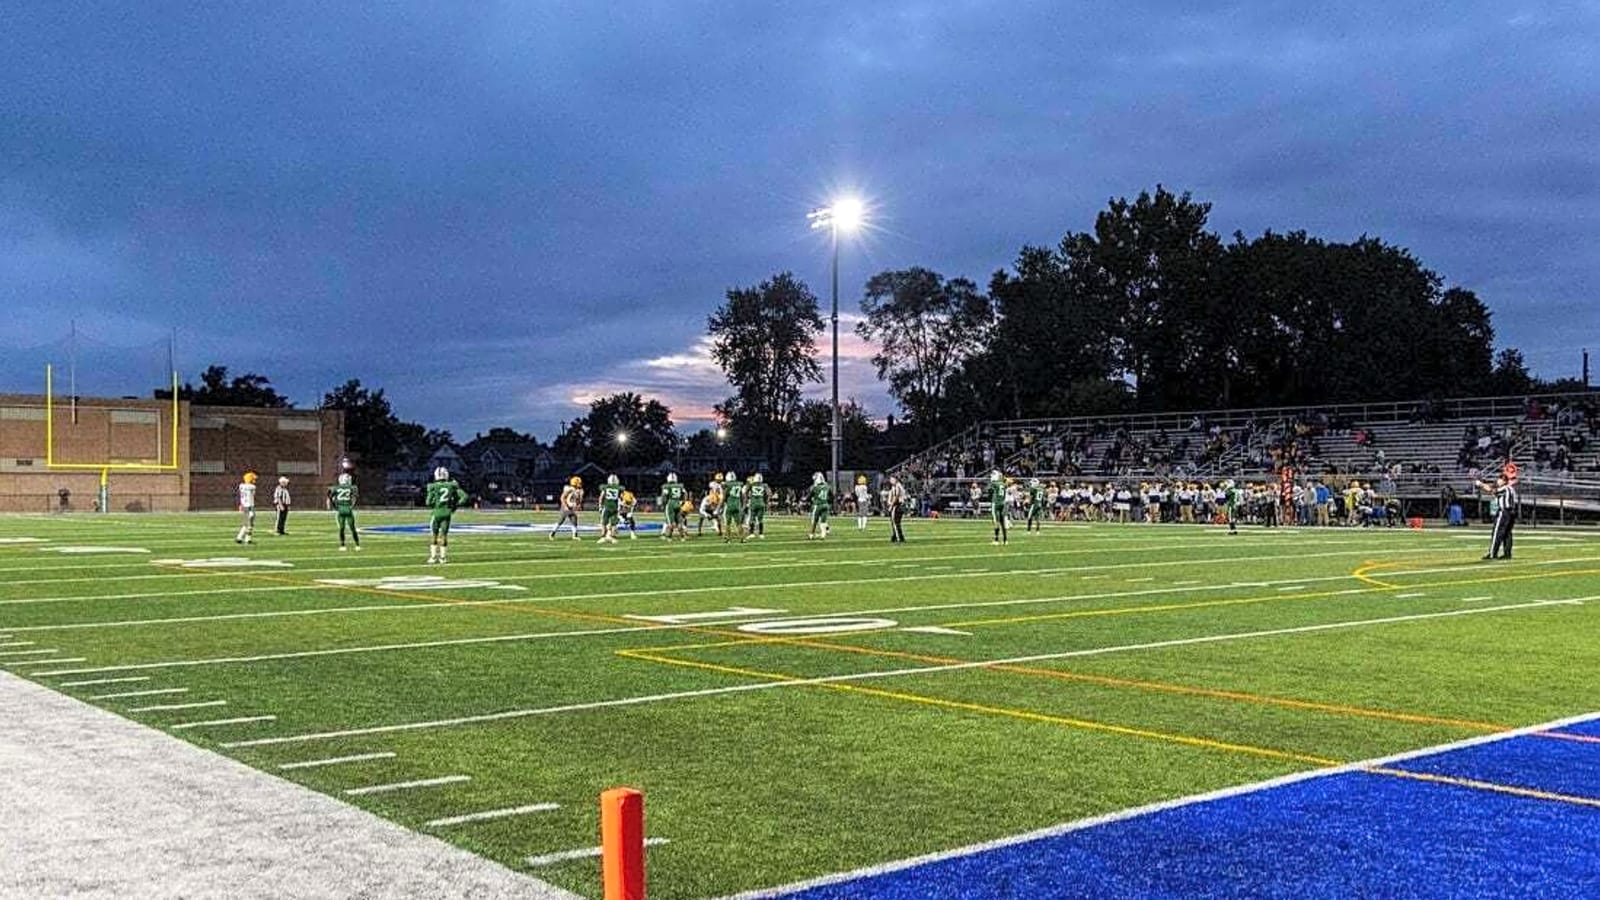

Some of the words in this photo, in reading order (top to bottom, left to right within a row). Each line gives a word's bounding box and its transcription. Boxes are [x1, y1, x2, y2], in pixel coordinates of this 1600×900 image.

[337, 488, 352, 501] 23
[439, 487, 449, 502] 2
[604, 488, 619, 500] 53
